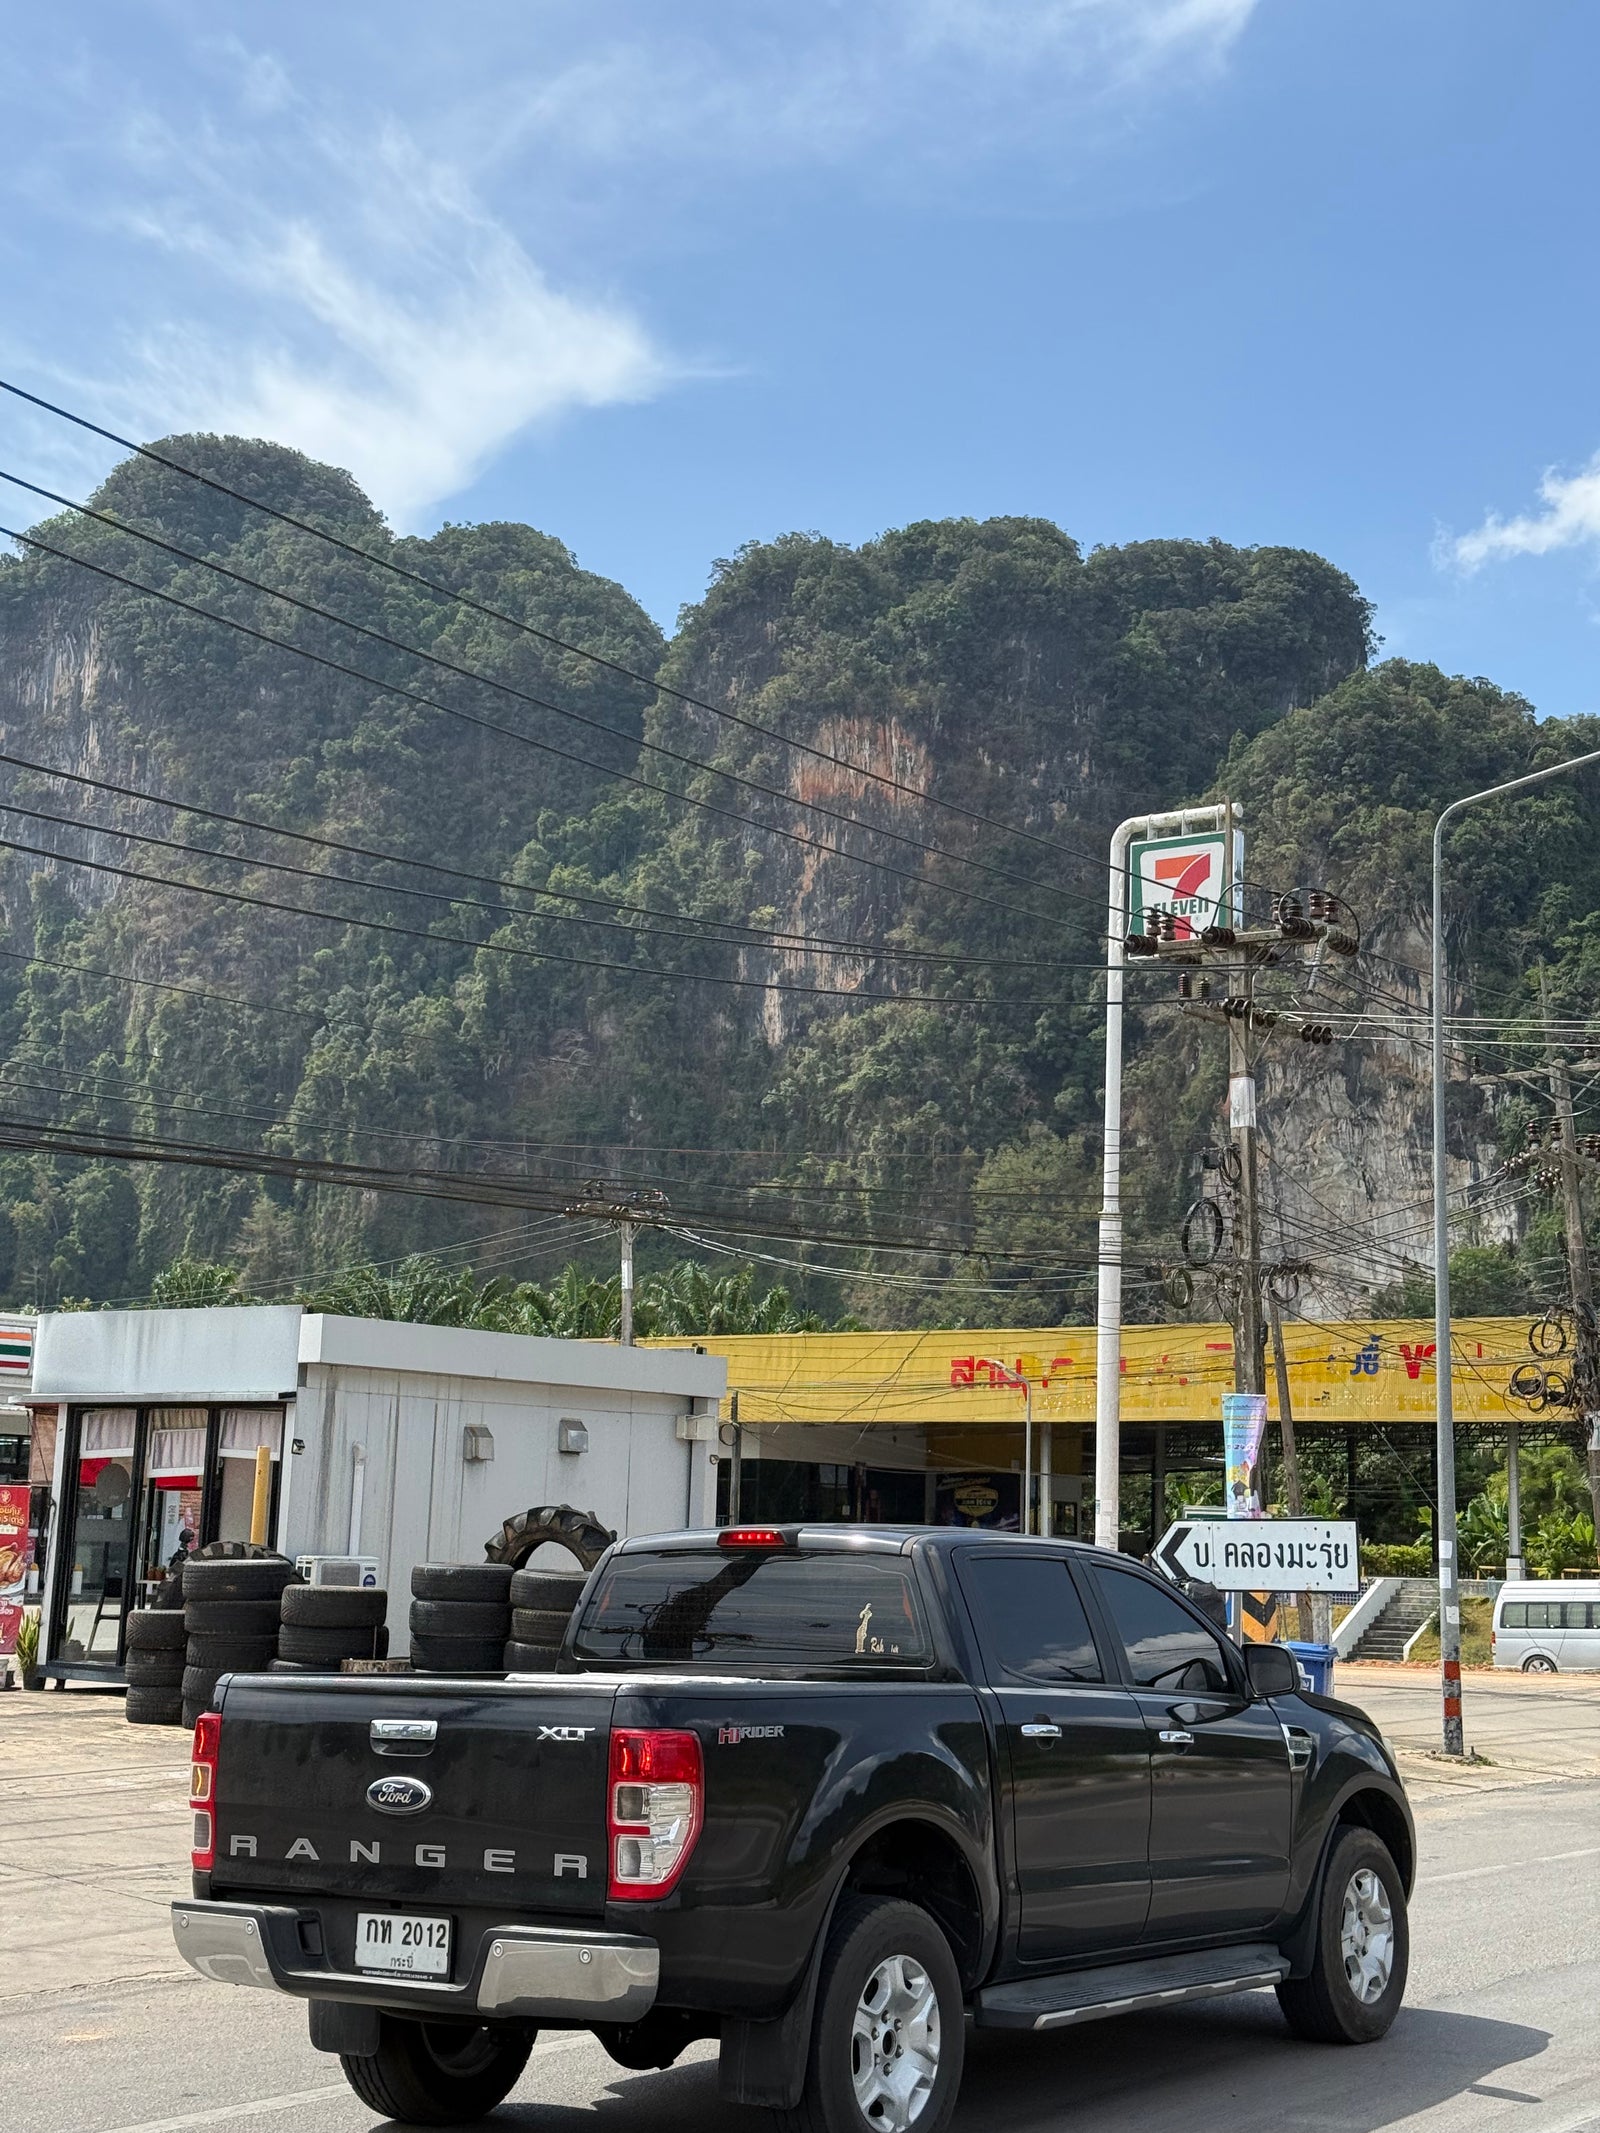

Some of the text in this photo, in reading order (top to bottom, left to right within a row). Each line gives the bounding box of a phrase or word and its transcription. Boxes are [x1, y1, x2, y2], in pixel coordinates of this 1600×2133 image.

[1154, 853, 1211, 940] 7
[1194, 1531, 1349, 1580] บ. คลองมะรุ่ย
[537, 1726, 596, 1742] XLT
[378, 1783, 414, 1804] Ford
[229, 1835, 588, 1879] RANGER
[366, 1918, 447, 1949] กท 2012
